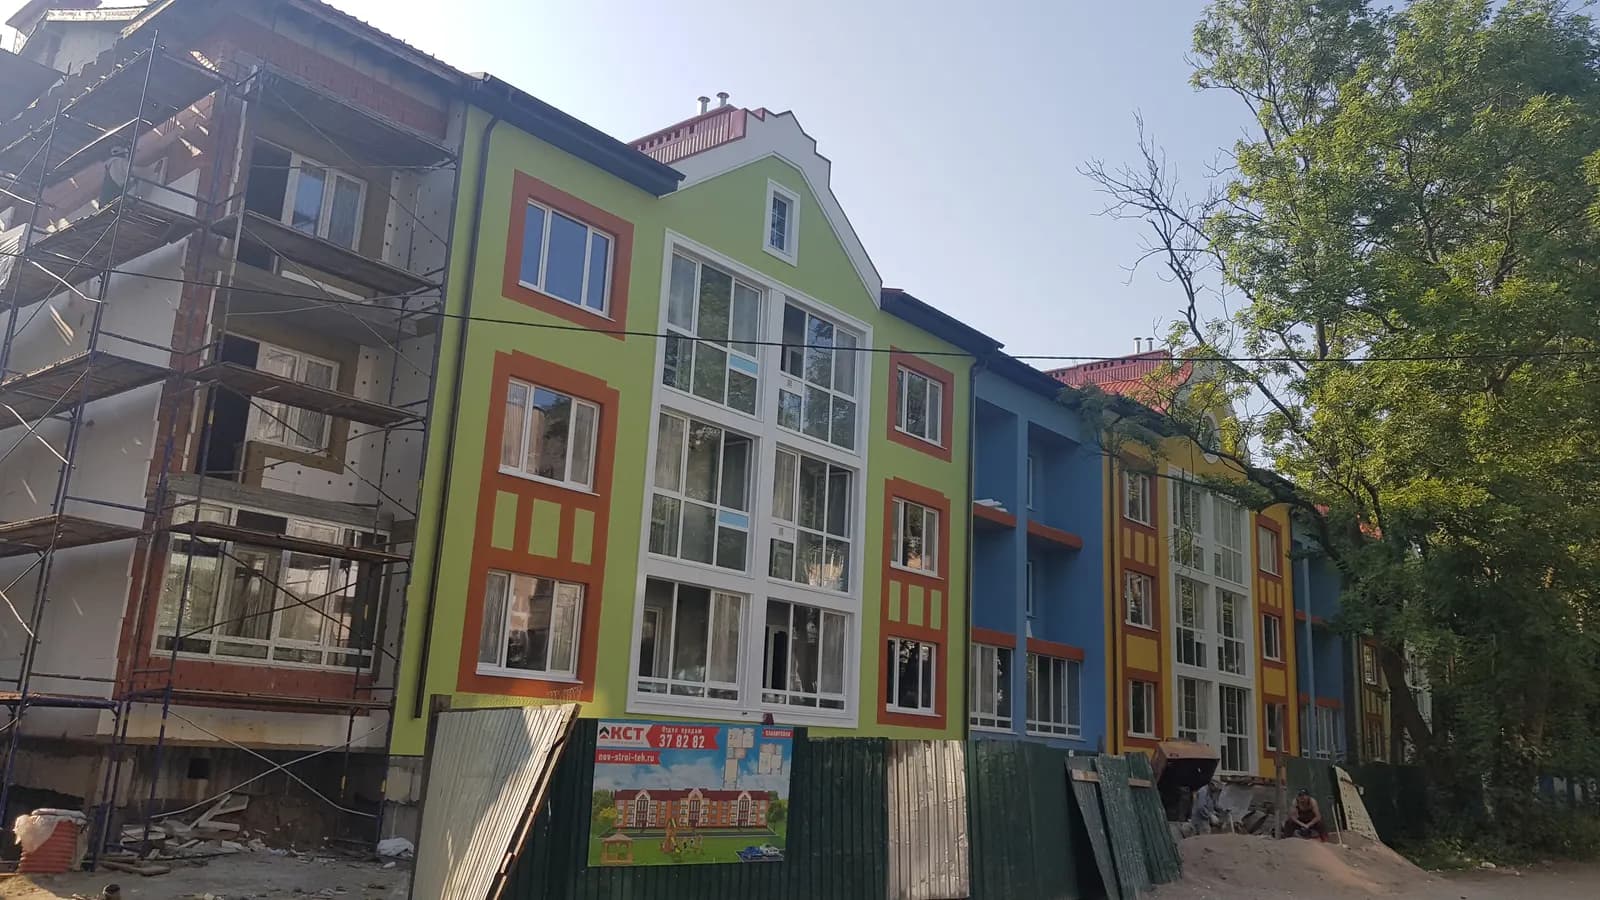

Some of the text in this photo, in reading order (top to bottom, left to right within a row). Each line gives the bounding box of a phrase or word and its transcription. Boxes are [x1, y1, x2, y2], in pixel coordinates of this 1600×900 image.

[659, 734, 705, 749] 37 82 82
